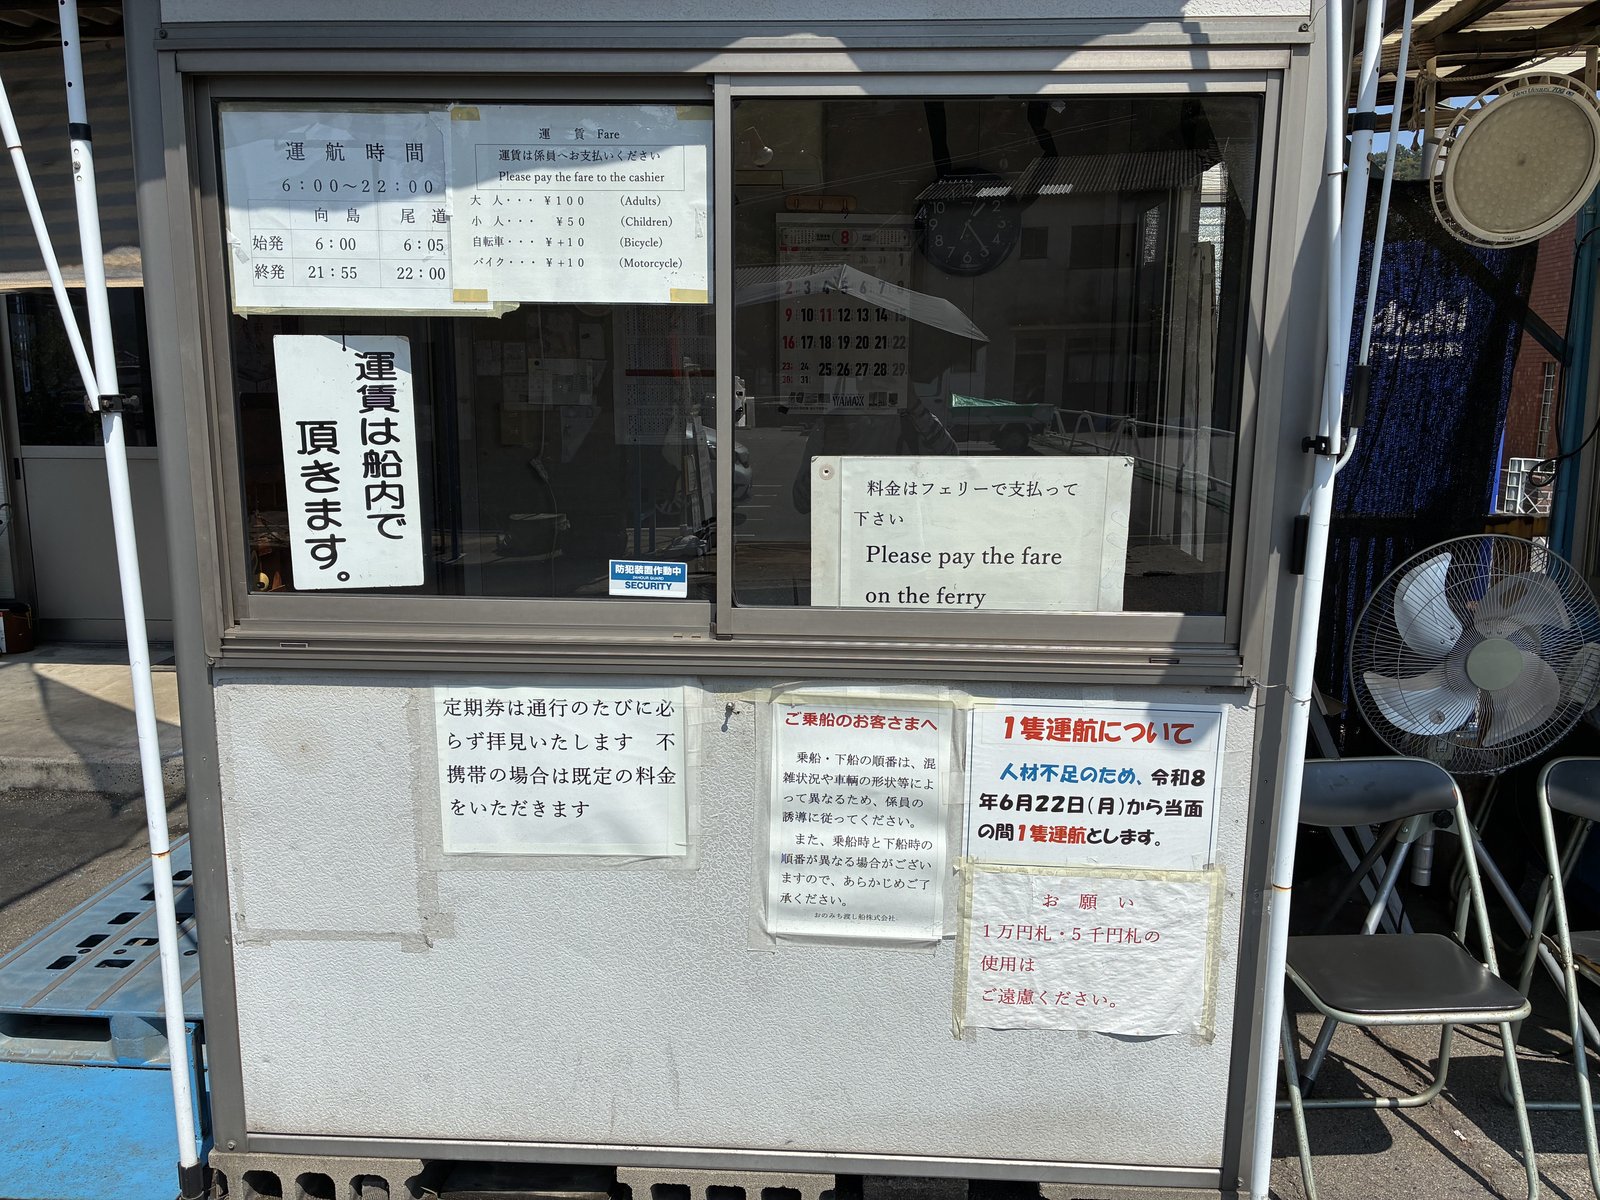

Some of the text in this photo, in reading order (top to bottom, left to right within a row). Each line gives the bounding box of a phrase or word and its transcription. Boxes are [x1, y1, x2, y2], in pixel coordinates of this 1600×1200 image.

[539, 128, 619, 140] 運賃 Fare
[286, 142, 424, 162] 運航時間
[499, 150, 660, 162] 運賃は係員へお支払いください
[499, 172, 664, 184] Please pay the fare to the cashier
[545, 196, 584, 205] ¥100
[620, 195, 661, 206] (Adults)
[315, 208, 447, 224] 向島 尾道
[556, 217, 584, 227] ¥50
[620, 216, 673, 227] (Children)
[253, 235, 444, 251] 始発 6:00 6:05
[619, 237, 663, 249] (Bicycle)
[841, 231, 849, 244] 8
[255, 264, 445, 280] 終発 21:55 22:00
[619, 258, 683, 269] (Motorcycle)
[786, 308, 792, 321] 9
[801, 308, 813, 321] 10
[820, 308, 832, 321] 11
[838, 308, 850, 321] 12
[857, 308, 868, 321] 13
[875, 308, 887, 321] 14
[783, 336, 906, 349] 16 17 18 19 20 21 22
[819, 363, 906, 376] 25 26 27 28 29
[800, 376, 808, 384] 31
[355, 352, 406, 539] 運賃は船内で
[867, 480, 1078, 497] 料金はフェリーで支払って
[296, 421, 350, 581] 頂きます。
[854, 511, 904, 526] 下さい
[866, 545, 1062, 569] Please pay the fare
[615, 565, 681, 576] 防犯装置作動中
[625, 582, 672, 590] SECURITY
[866, 587, 986, 608] on the ferry
[443, 698, 675, 717] 定期券は通行のたびに必
[785, 711, 937, 731] ご乗船のお客さまへ
[1004, 716, 1195, 745] 1隻運航について
[448, 732, 675, 751] らず拝見いたします 不
[797, 752, 936, 770] 乗船・下船の順番は、混
[447, 765, 676, 785] 携帯の場合は既定の料金
[999, 762, 1206, 786] 人材不足のため、令和8
[451, 799, 589, 818] をいただきます
[784, 793, 923, 808] って異なるため、係員の
[783, 811, 917, 828] 誘導に従ってください。
[795, 833, 932, 850] また、乗船時と下船時の
[978, 824, 1161, 847] の間1隻運航とします。
[781, 853, 931, 870] 順番が異なる場合がござい
[781, 873, 930, 890] ますので、あらかじめご了
[780, 893, 849, 907] 承ください。
[1043, 893, 1134, 910] お願い
[814, 912, 896, 922] おのみち渡し船株式会社
[983, 924, 1160, 944] 1万円札・5千円札の
[981, 955, 1034, 972] 使用は
[982, 988, 1117, 1008] ご遠慮ください。
